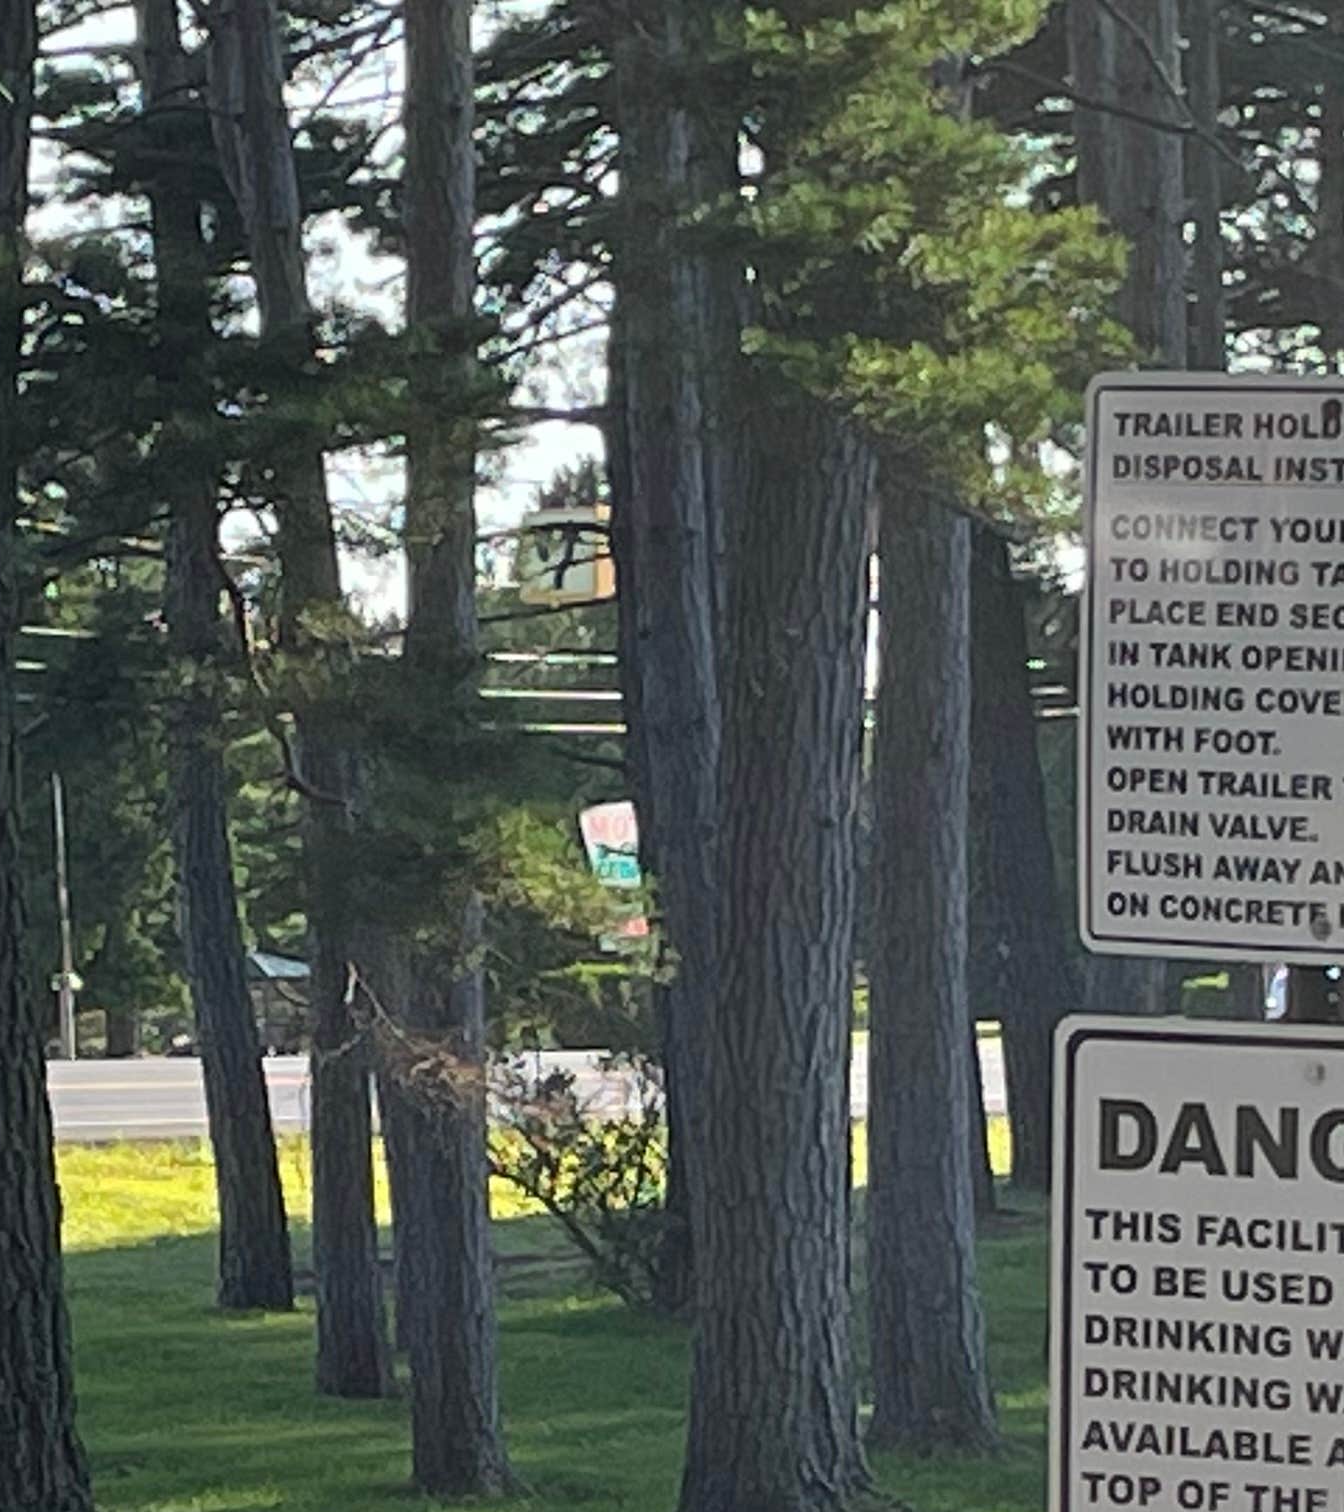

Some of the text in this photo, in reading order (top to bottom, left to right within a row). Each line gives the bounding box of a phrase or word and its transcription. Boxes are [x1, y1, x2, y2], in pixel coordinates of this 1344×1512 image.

[1113, 412, 1243, 439] TRAILER
[1113, 454, 1263, 482] DISPOSAL
[1111, 514, 1260, 543] CONNECT
[1109, 557, 1149, 583] TO
[1159, 558, 1300, 586] HOLDING
[1109, 598, 1207, 627] PLACE
[1216, 602, 1279, 628] END
[1108, 641, 1140, 666] IN
[1149, 642, 1232, 670] TANK
[1107, 682, 1244, 712] HOLDING
[1107, 725, 1281, 756] WITH FOOT.
[1107, 766, 1188, 795] OPEN
[1197, 770, 1333, 801] TRAILER
[1107, 809, 1319, 843] DRAIN VALVE.
[1107, 849, 1203, 879] FLUSH
[1212, 855, 1302, 884] AWAY
[1107, 891, 1149, 918] ON
[1159, 894, 1328, 929] CONCRETE
[1085, 1208, 1181, 1244] THIS
[1083, 1261, 1138, 1294] TO
[1153, 1266, 1207, 1299] BE
[1222, 1269, 1333, 1306] USED
[1084, 1314, 1291, 1358] DRINKING
[1083, 1367, 1291, 1411] DRINKING
[1081, 1420, 1312, 1466] AVAILABLE
[1081, 1471, 1162, 1507] TOP
[1177, 1479, 1230, 1512] OF
